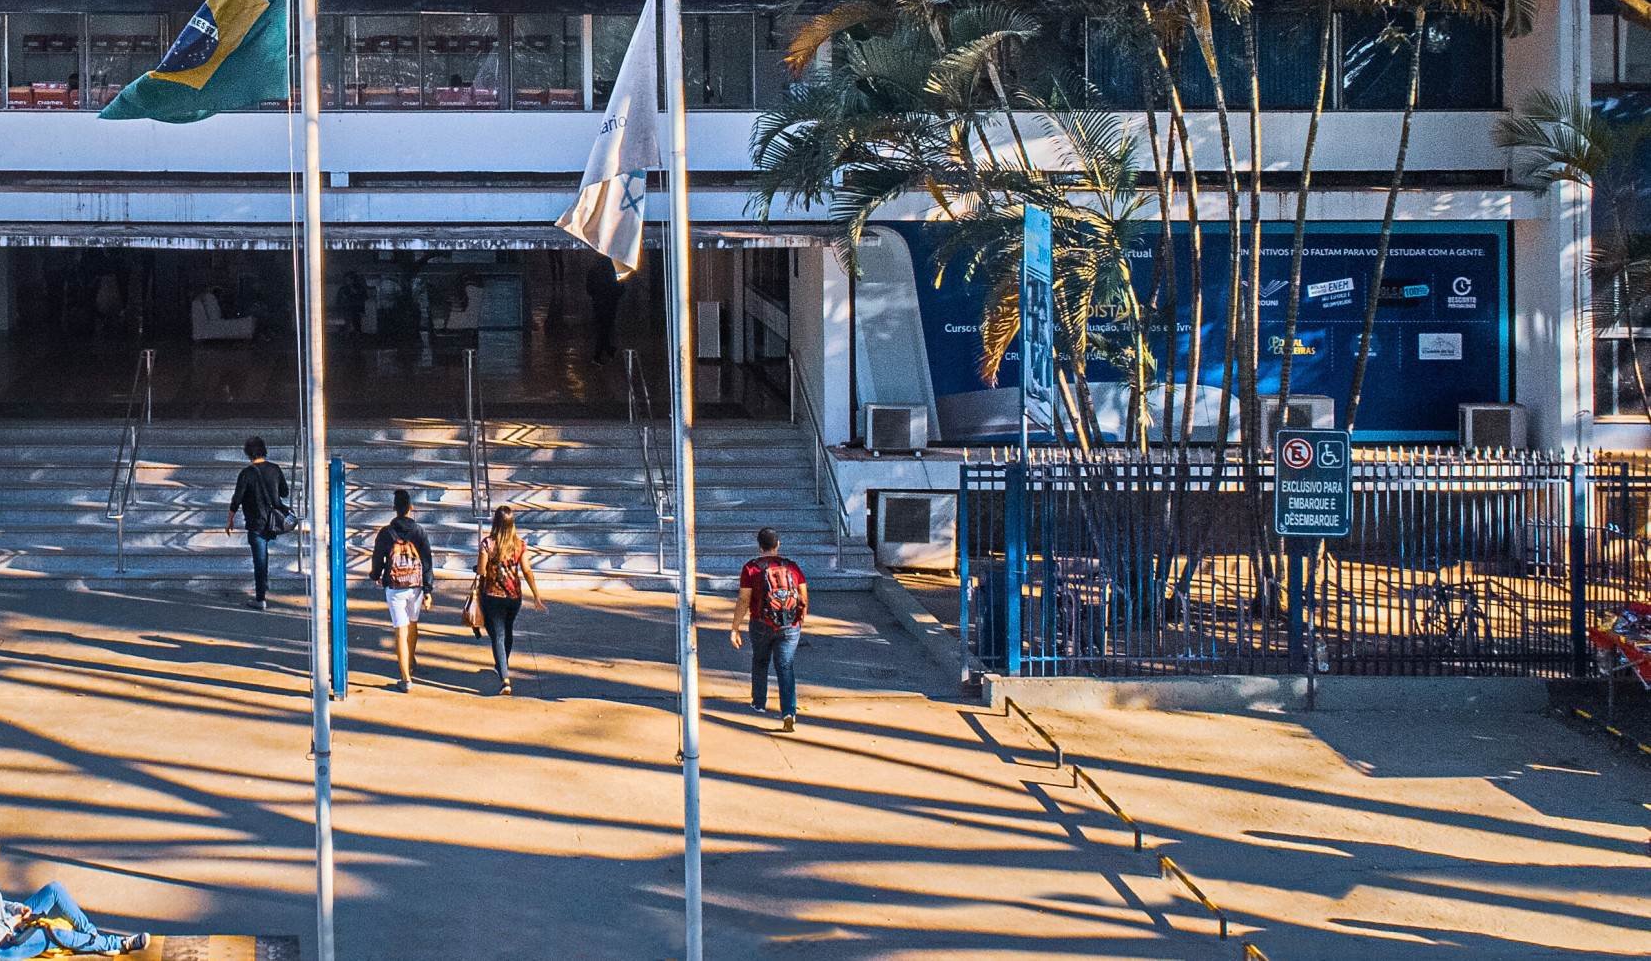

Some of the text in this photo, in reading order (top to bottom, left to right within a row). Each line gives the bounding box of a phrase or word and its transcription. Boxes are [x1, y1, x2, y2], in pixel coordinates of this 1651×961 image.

[1310, 248, 1342, 256] FALTAM
[1343, 248, 1365, 256] PARA
[1389, 248, 1427, 256] ESTUDAR
[1427, 248, 1448, 256] COM
[1448, 248, 1456, 256] A
[944, 323, 977, 333] Cursos
[1323, 480, 1343, 493] PARA
